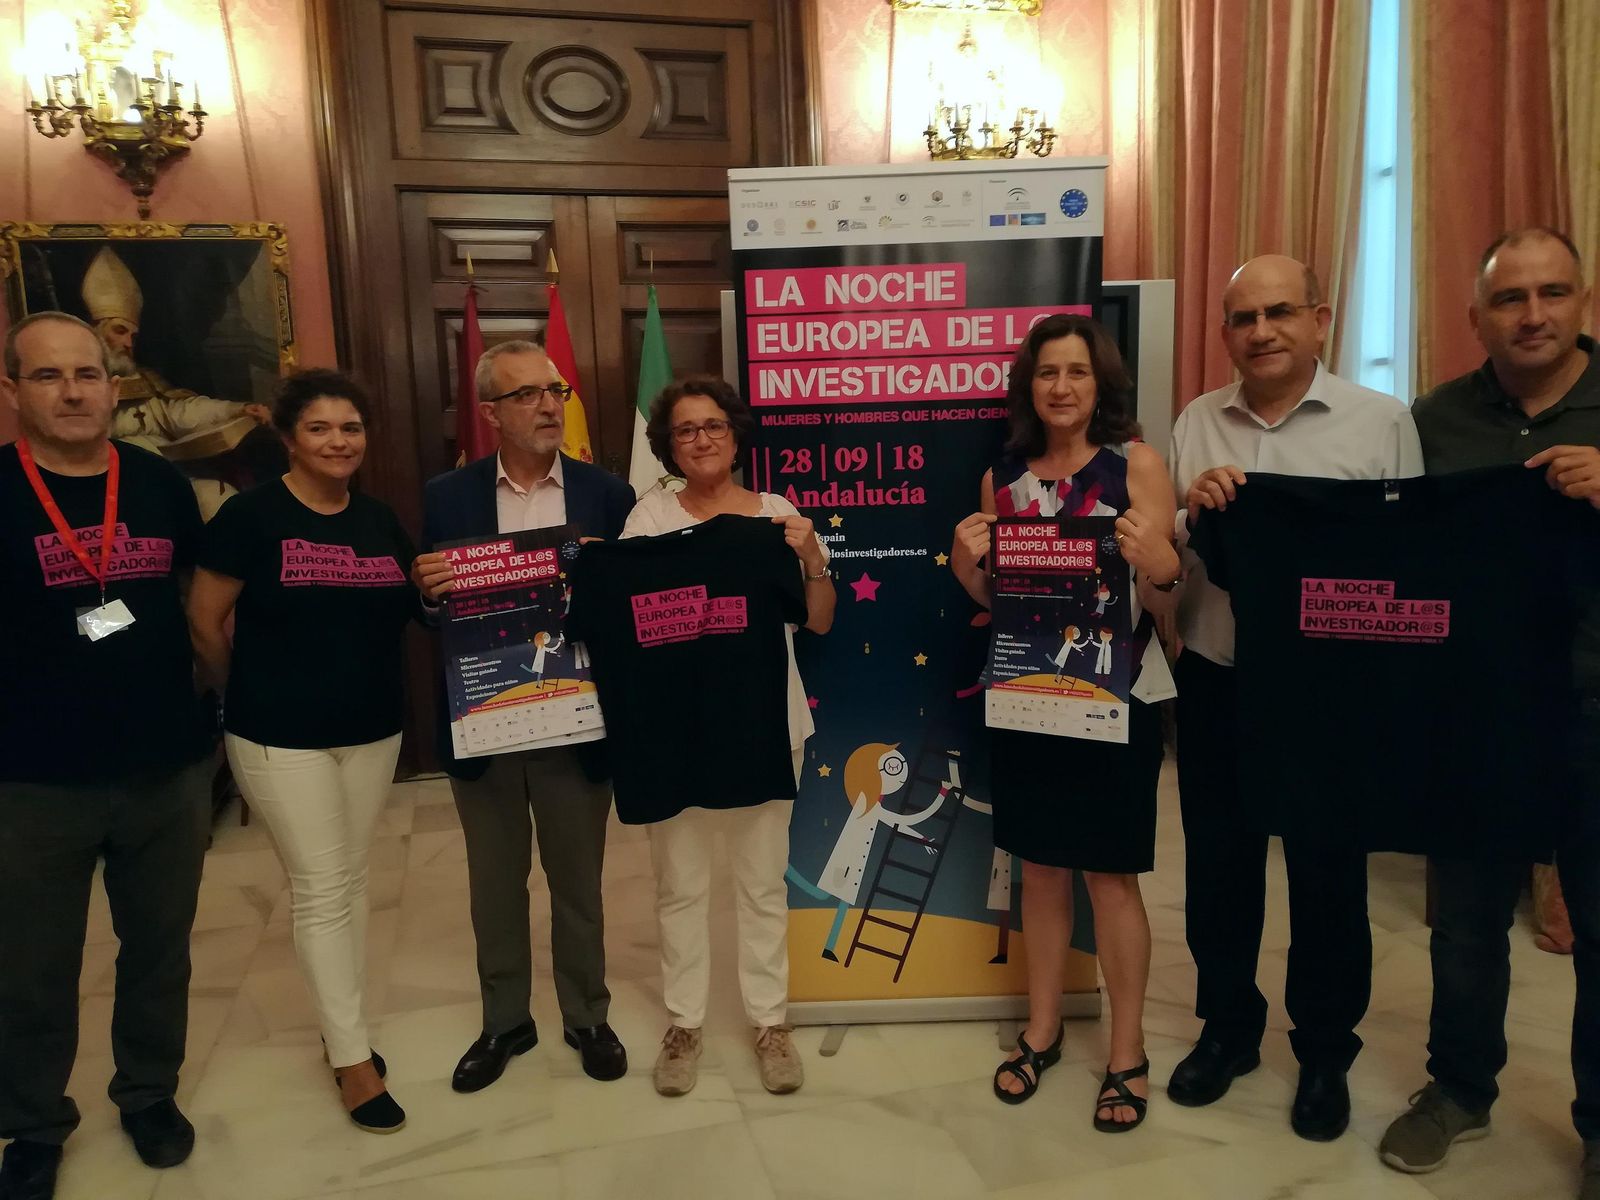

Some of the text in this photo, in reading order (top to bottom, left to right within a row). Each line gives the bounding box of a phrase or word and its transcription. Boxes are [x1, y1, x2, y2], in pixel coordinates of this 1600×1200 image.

[755, 270, 956, 307] LA NOCHE
[757, 318, 931, 354] EUROPEA
[947, 315, 994, 347] DE
[761, 408, 1011, 426] MUJERES Y HOMBRES QUE HACEN CIEN
[779, 445, 925, 474] 28 09 18
[784, 480, 927, 508] Andalucía
[999, 526, 1056, 537] LA NOCHE
[40, 535, 62, 549] LA
[124, 541, 144, 553] DE
[286, 541, 351, 556] LA NOCHE
[466, 542, 511, 559] NOCHE
[999, 541, 1049, 551] EUROPEA
[1053, 541, 1067, 552] DE
[1069, 541, 1093, 552] L@S
[286, 555, 349, 568] EUROPEA
[352, 558, 369, 569] DE
[829, 547, 928, 559] losinvestigadores.es
[999, 555, 1093, 567] INVESTIGADOR@S
[453, 550, 554, 575] UROPEA DE L@S
[453, 564, 556, 590] NVESTIGADOR@S
[1305, 581, 1390, 596] LA NOCHE
[635, 588, 704, 609] LA NOCHE
[1305, 598, 1445, 616] EUROPEA DE L@S
[638, 599, 743, 624] EUROPEA DE L@S
[640, 615, 744, 639] INVESTIGADOR@S
[1304, 616, 1445, 634] INVESTIGADOR@S
